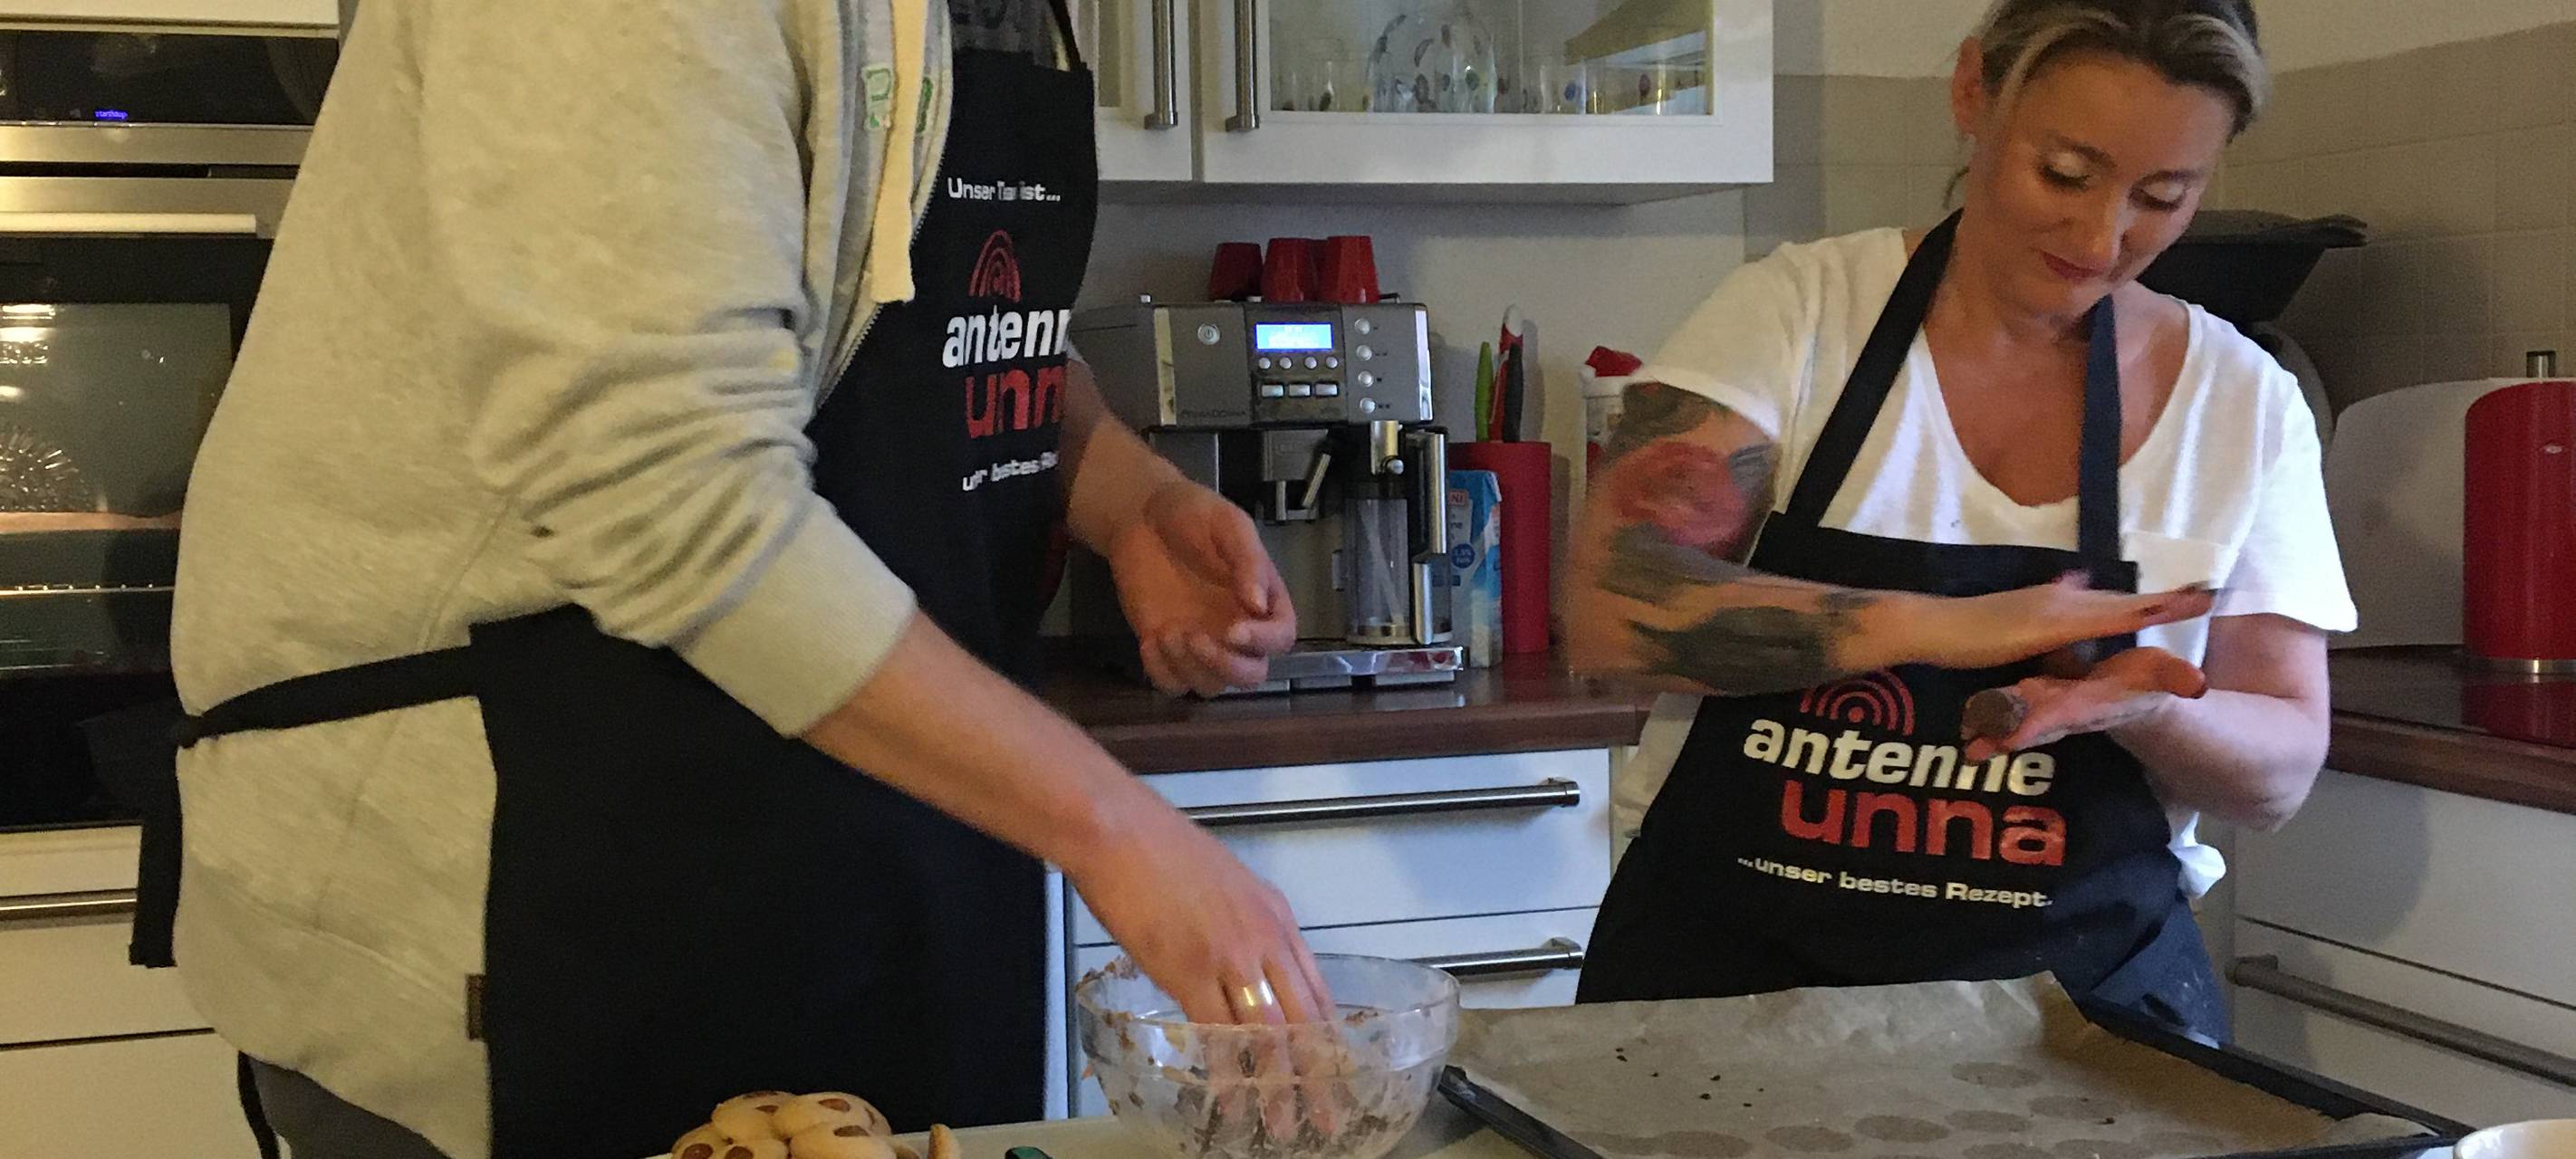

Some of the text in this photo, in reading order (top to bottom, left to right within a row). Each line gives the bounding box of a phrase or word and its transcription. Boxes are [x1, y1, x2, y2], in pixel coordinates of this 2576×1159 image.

[947, 177, 995, 200] Unser
[942, 304, 1070, 369] anten
[965, 365, 1066, 439] unn
[1743, 718, 2056, 796] antenne
[1781, 781, 2068, 867] unna
[1839, 871, 1938, 899] bestes
[1945, 881, 2053, 909] Rezept.
